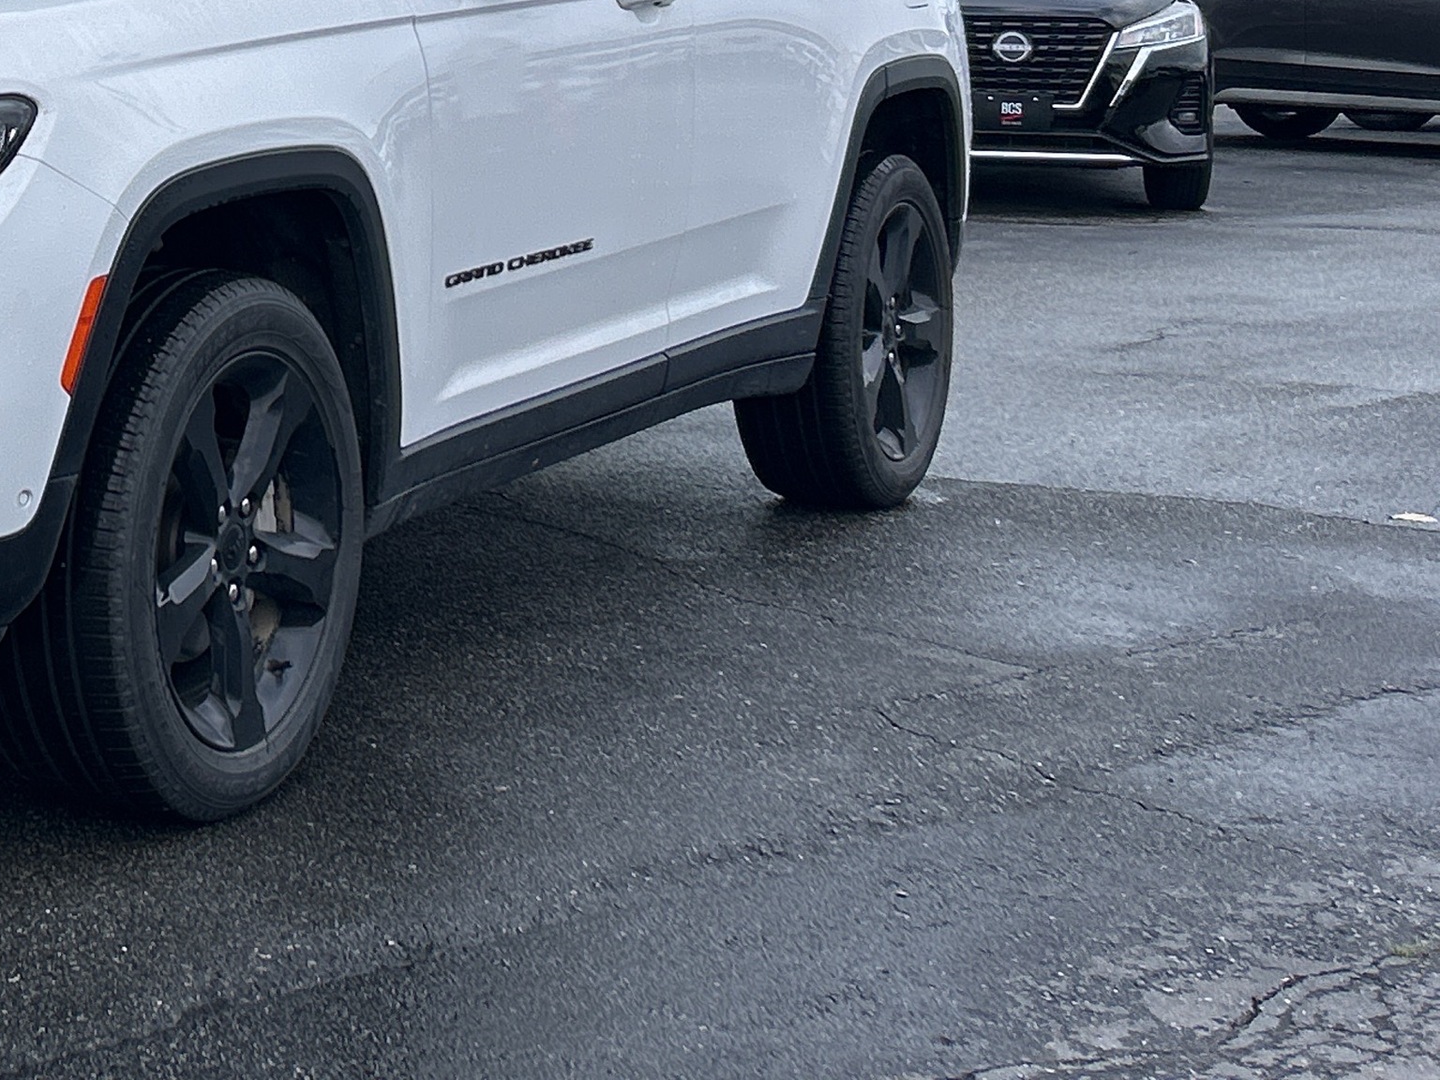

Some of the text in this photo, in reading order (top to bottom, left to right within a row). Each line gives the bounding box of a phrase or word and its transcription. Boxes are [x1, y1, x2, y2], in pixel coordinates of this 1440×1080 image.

[1001, 102, 1023, 115] BCS
[445, 238, 594, 288] GRAND CHEROKEE
